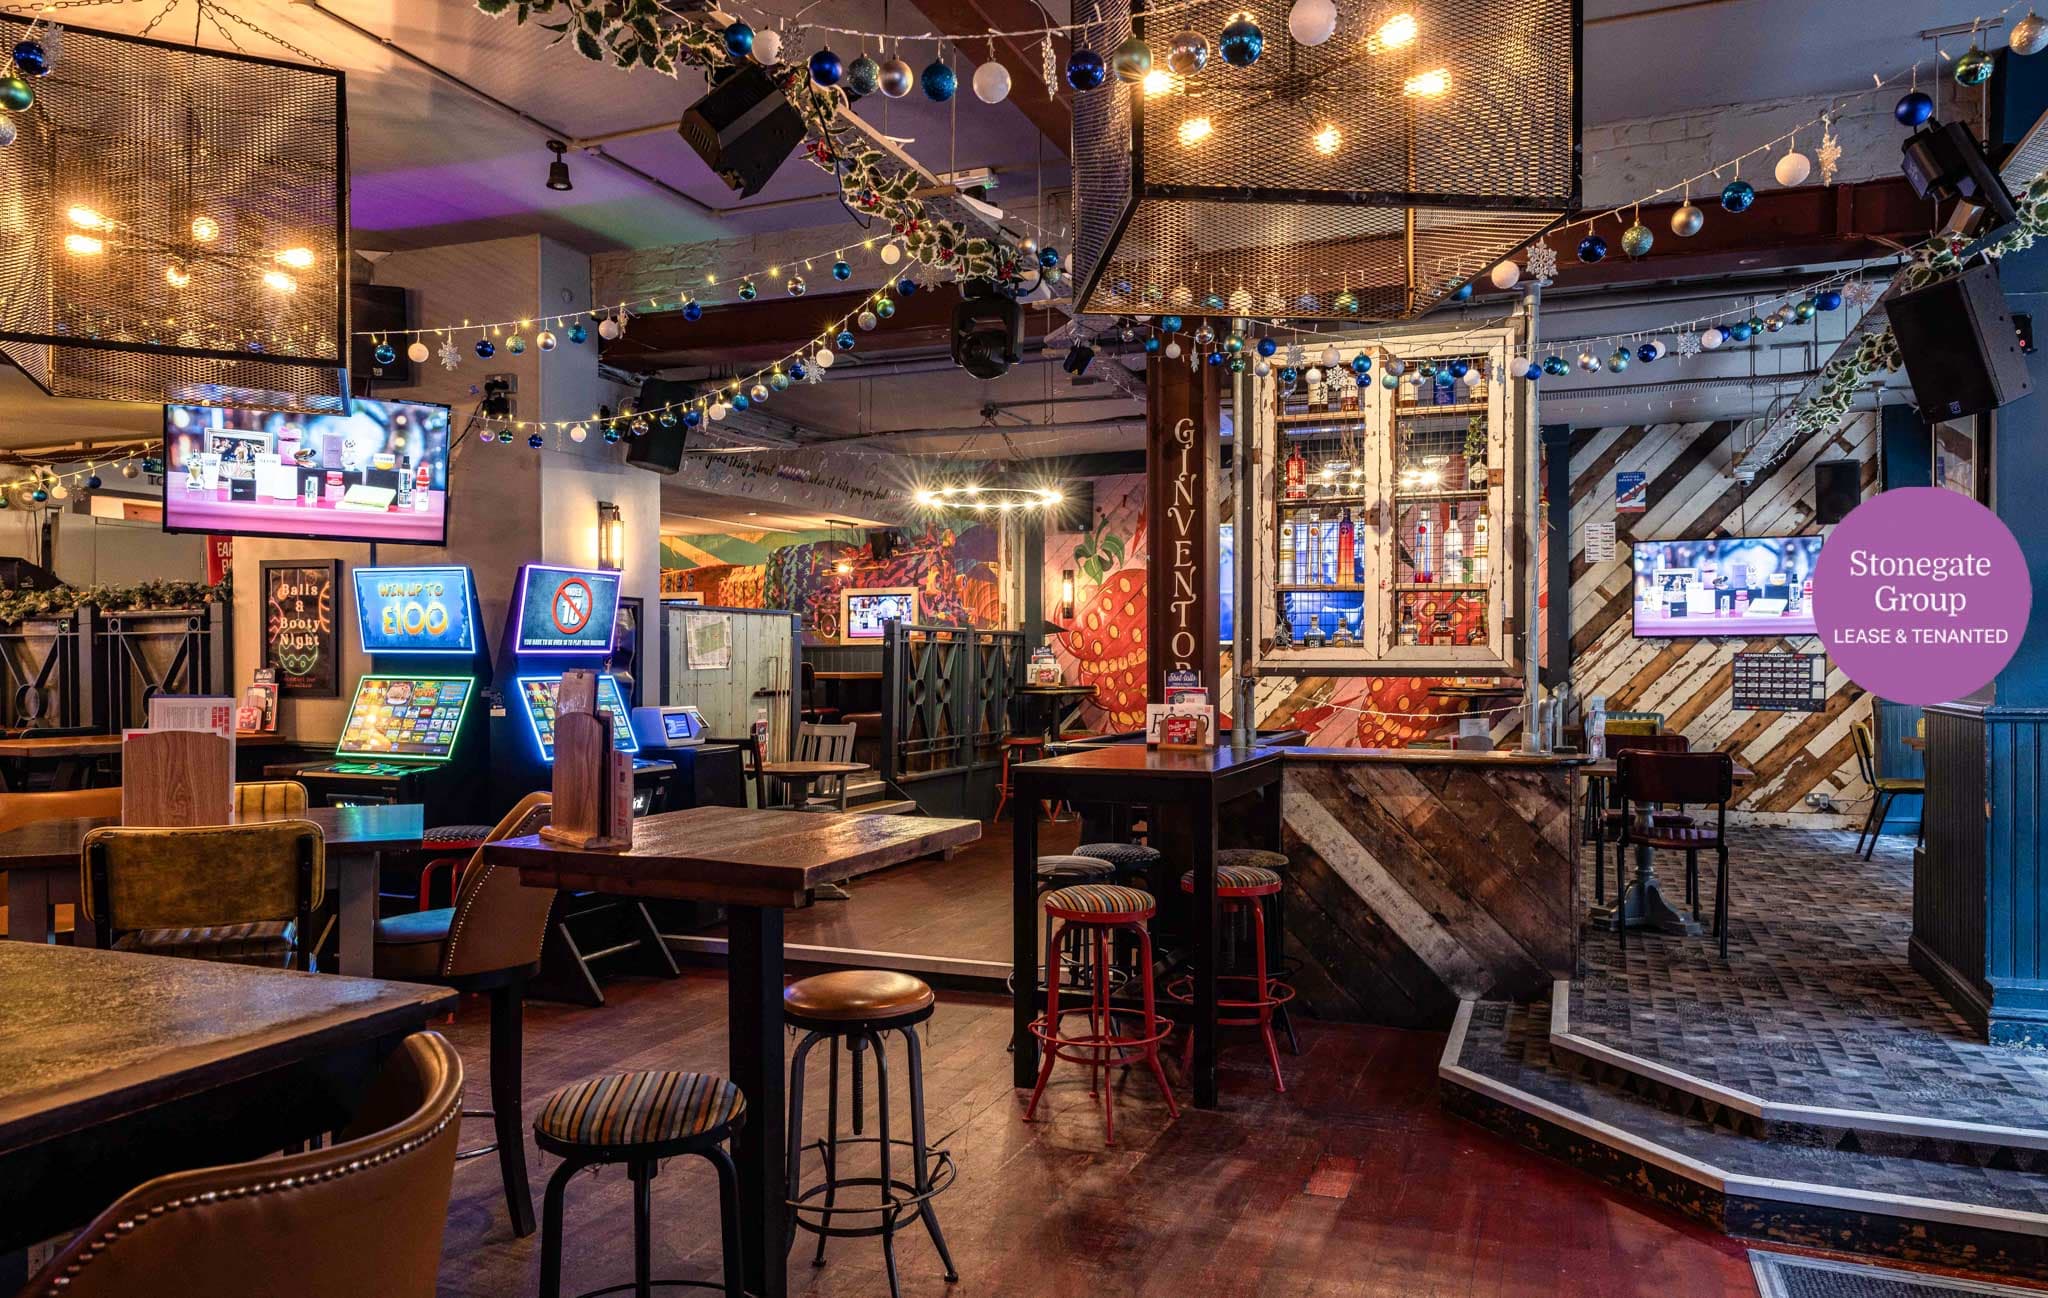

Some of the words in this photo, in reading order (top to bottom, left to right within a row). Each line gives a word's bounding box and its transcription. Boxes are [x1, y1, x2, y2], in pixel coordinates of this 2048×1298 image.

[282, 583, 319, 596] Balls
[378, 583, 405, 597] WIN
[408, 583, 423, 597] UP
[426, 583, 444, 597] TO
[295, 600, 305, 612] &
[280, 617, 320, 633] Booty
[382, 601, 449, 636] £100
[280, 633, 320, 650] Night
